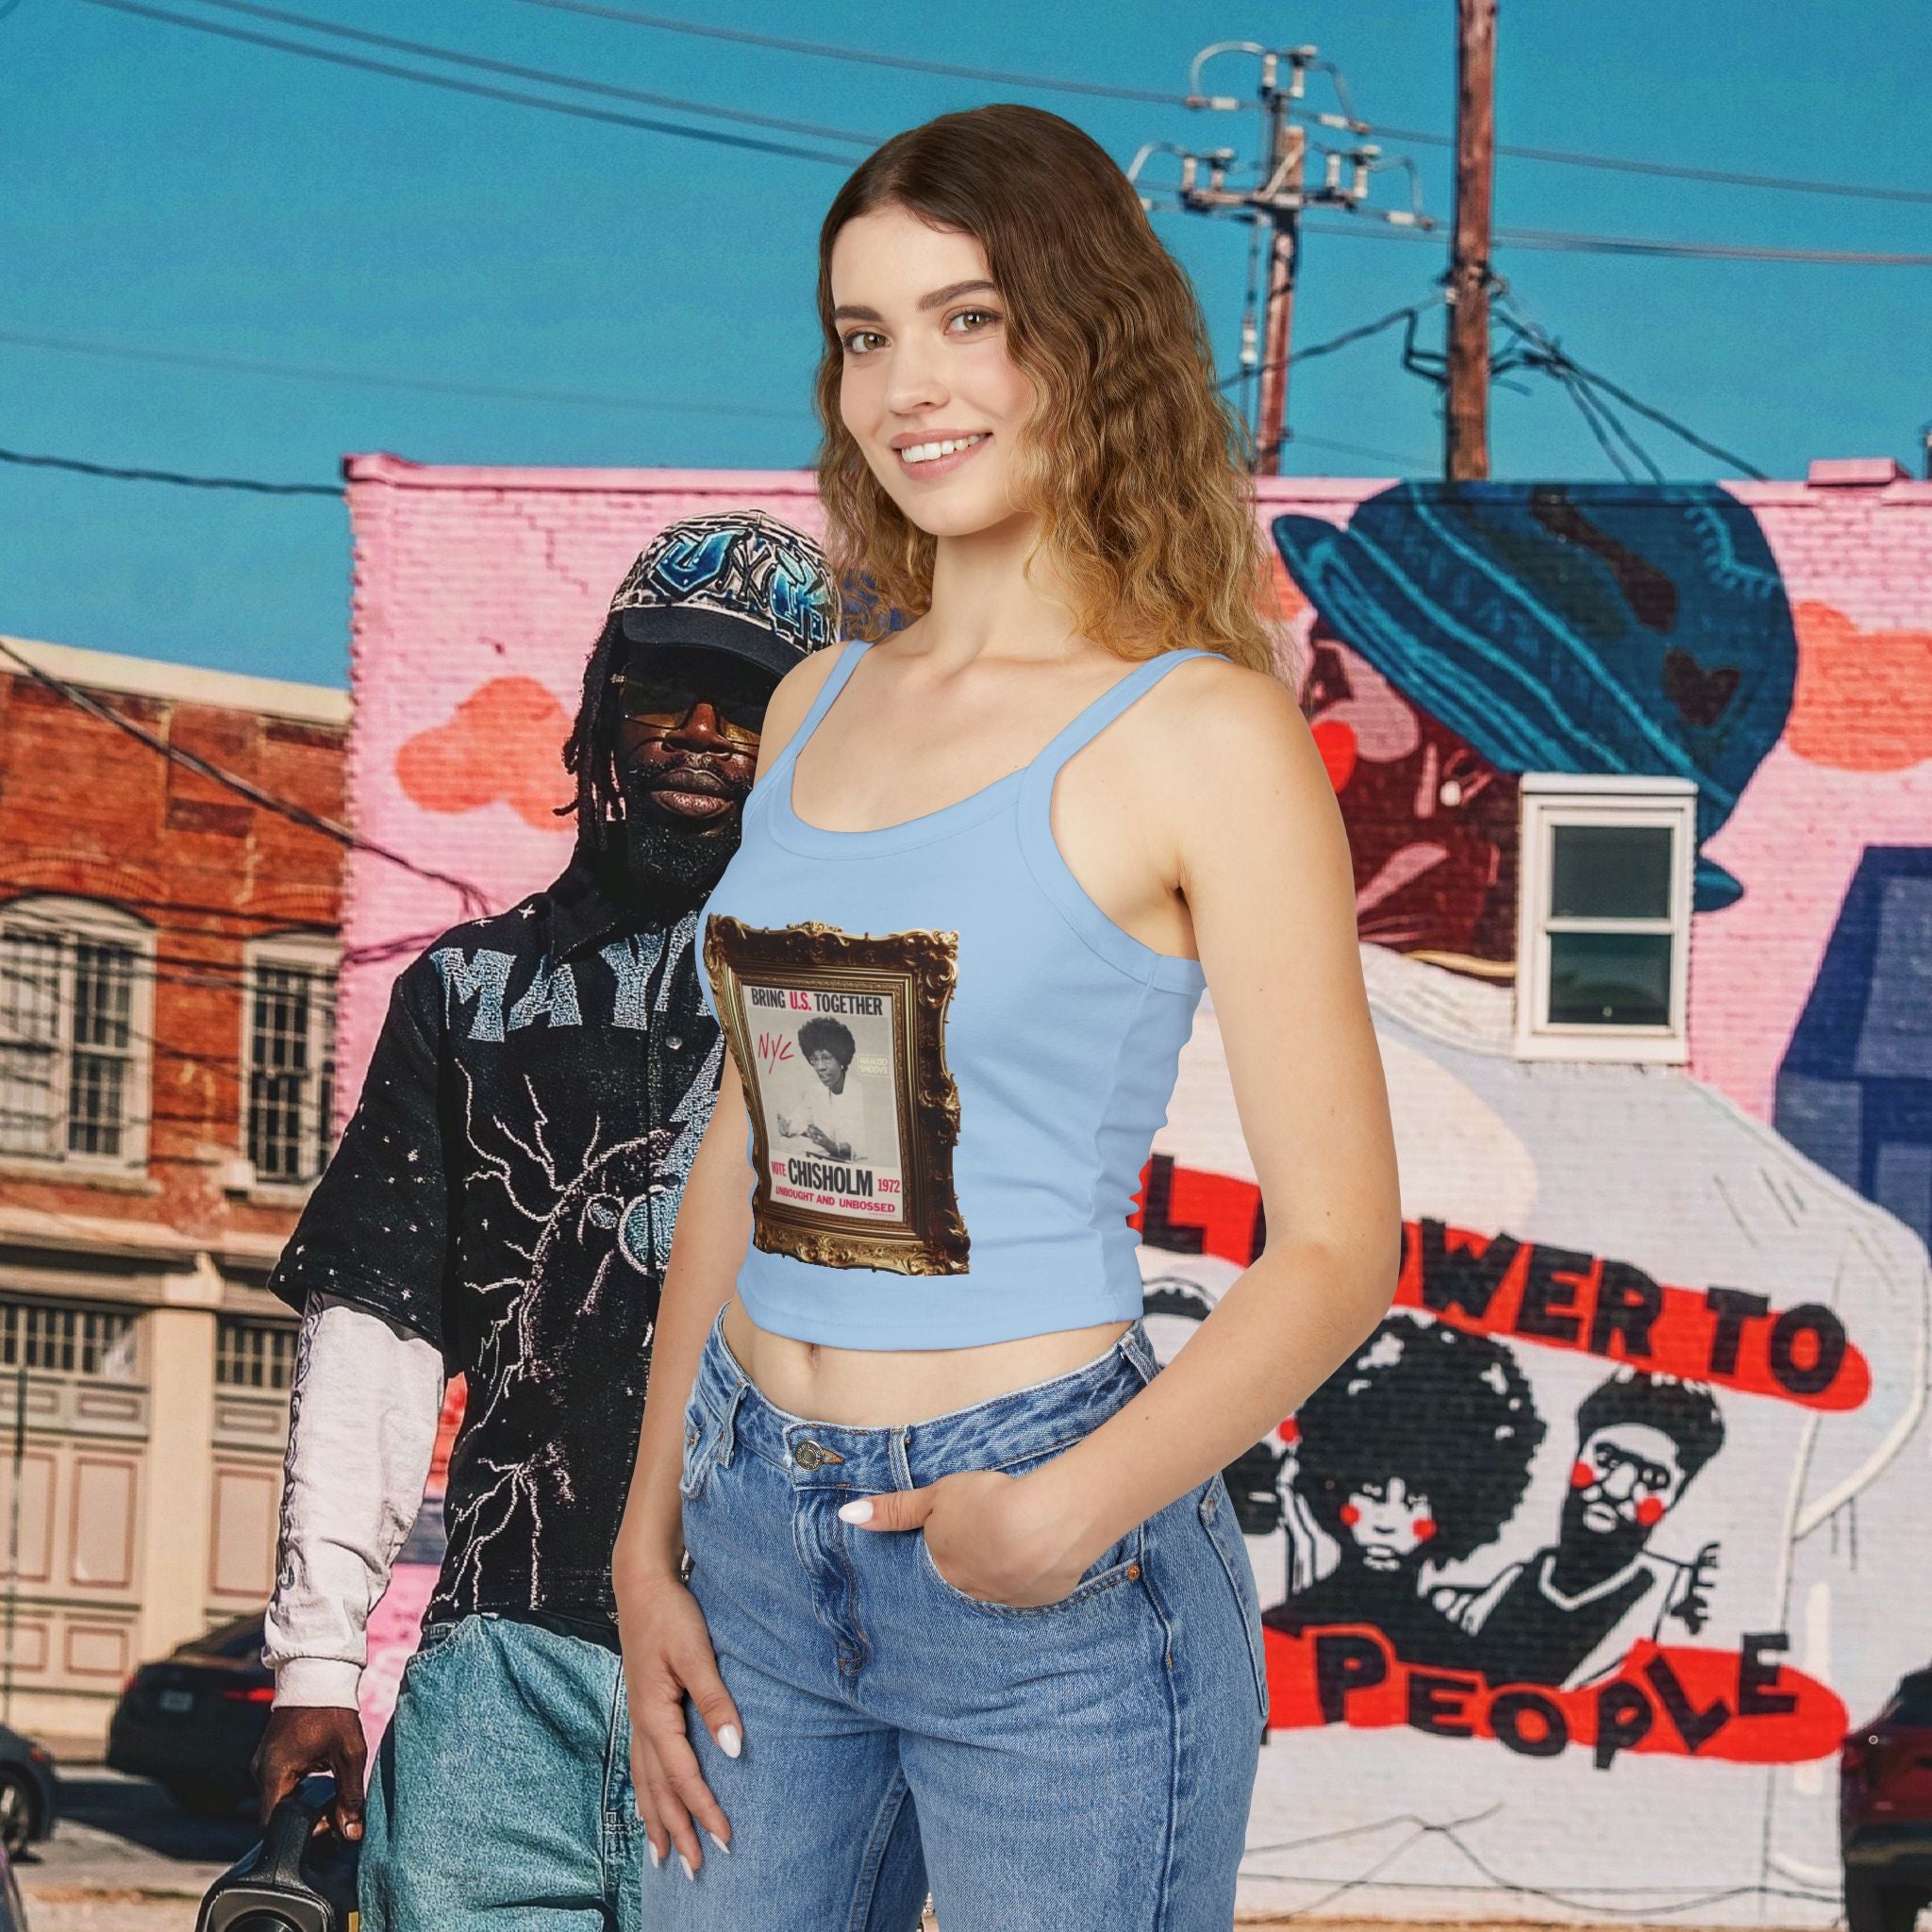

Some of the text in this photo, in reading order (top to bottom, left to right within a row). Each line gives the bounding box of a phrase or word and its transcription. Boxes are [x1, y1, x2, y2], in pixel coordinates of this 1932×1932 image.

[751, 988, 882, 1016] BRING U.S. TOGETHER
[758, 1032, 794, 1074] NYC
[771, 1158, 901, 1197] VOTE CHISHOLM 1972
[775, 1185, 895, 1213] UNBOUGHT AND UNBOSSED
[1400, 1218, 1662, 1357] WER
[1706, 1286, 1845, 1395] TO
[1316, 1633, 1798, 1770] PEOPLE
